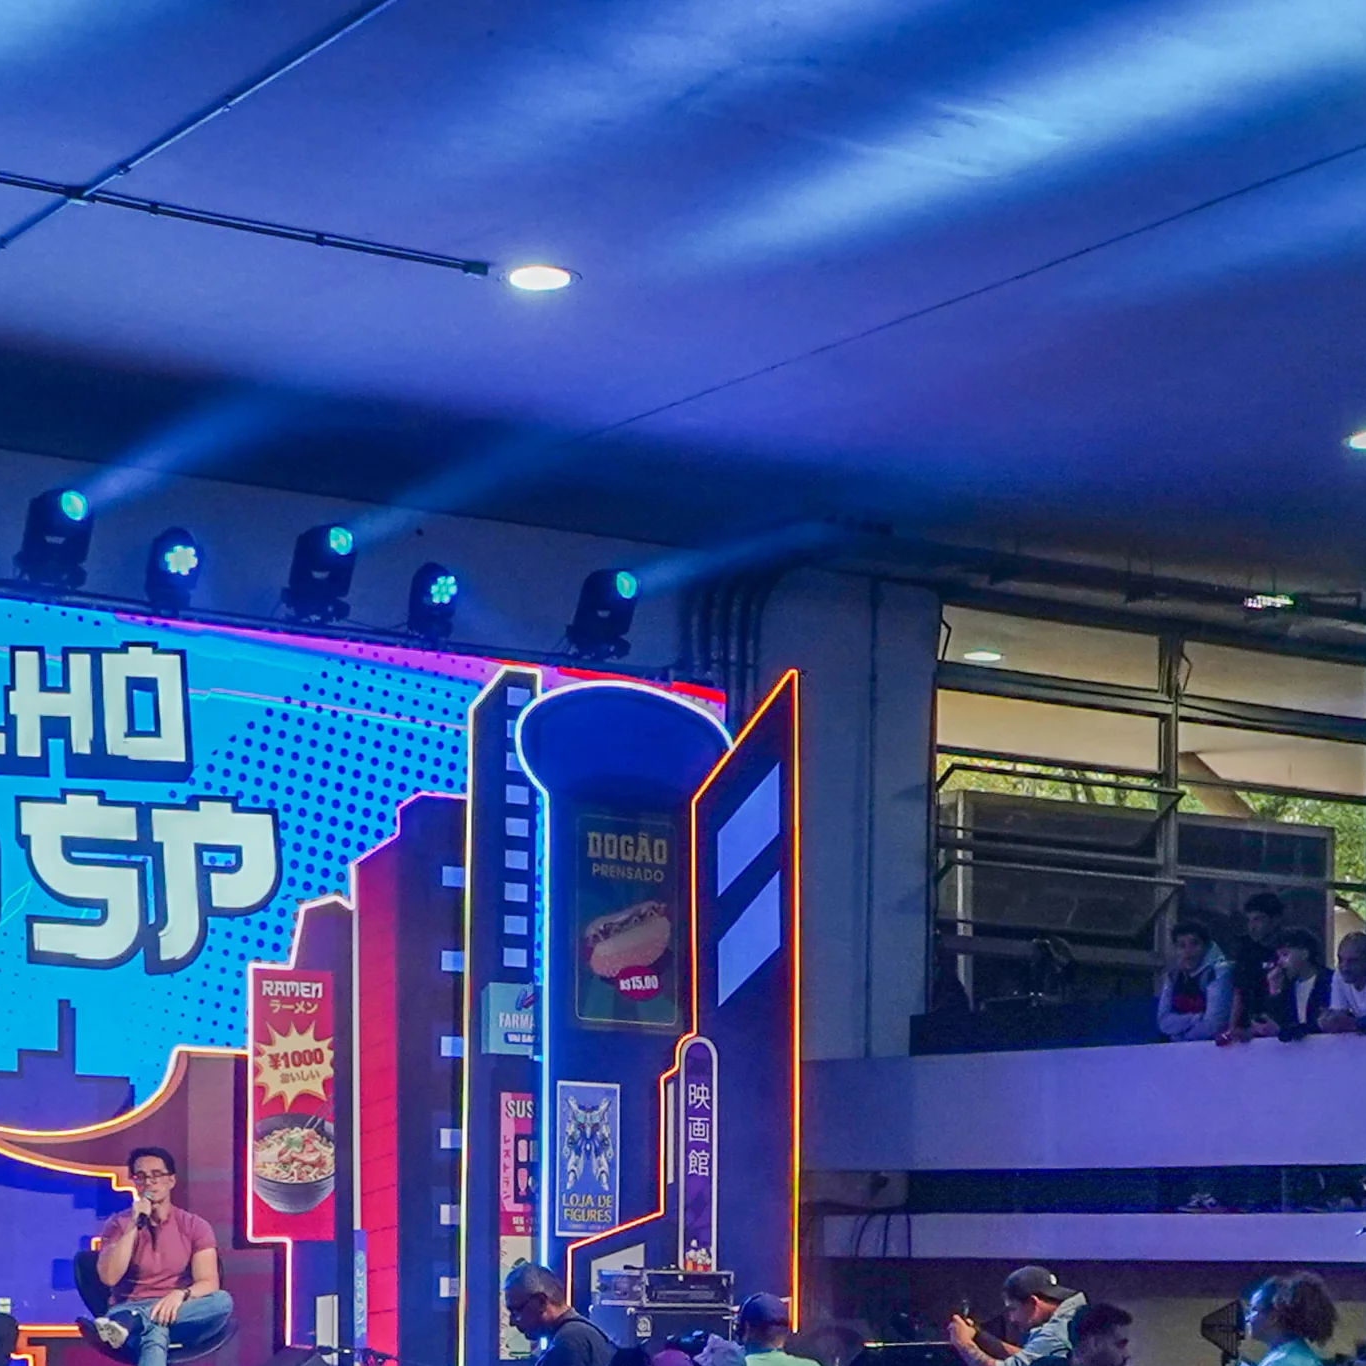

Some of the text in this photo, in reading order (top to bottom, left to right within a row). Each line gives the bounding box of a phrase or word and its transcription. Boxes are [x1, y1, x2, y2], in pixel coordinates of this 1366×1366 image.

[587, 831, 668, 865] DOGÃO
[19, 792, 280, 963] SP
[592, 862, 664, 883] PRENSADO
[261, 980, 323, 999] RAMEN
[269, 999, 319, 1015] ラーメン
[267, 1047, 325, 1070] ¥1000
[688, 1082, 711, 1177] 映画館
[562, 1193, 613, 1208] LOJA DE
[564, 1208, 613, 1222] FIGURES
